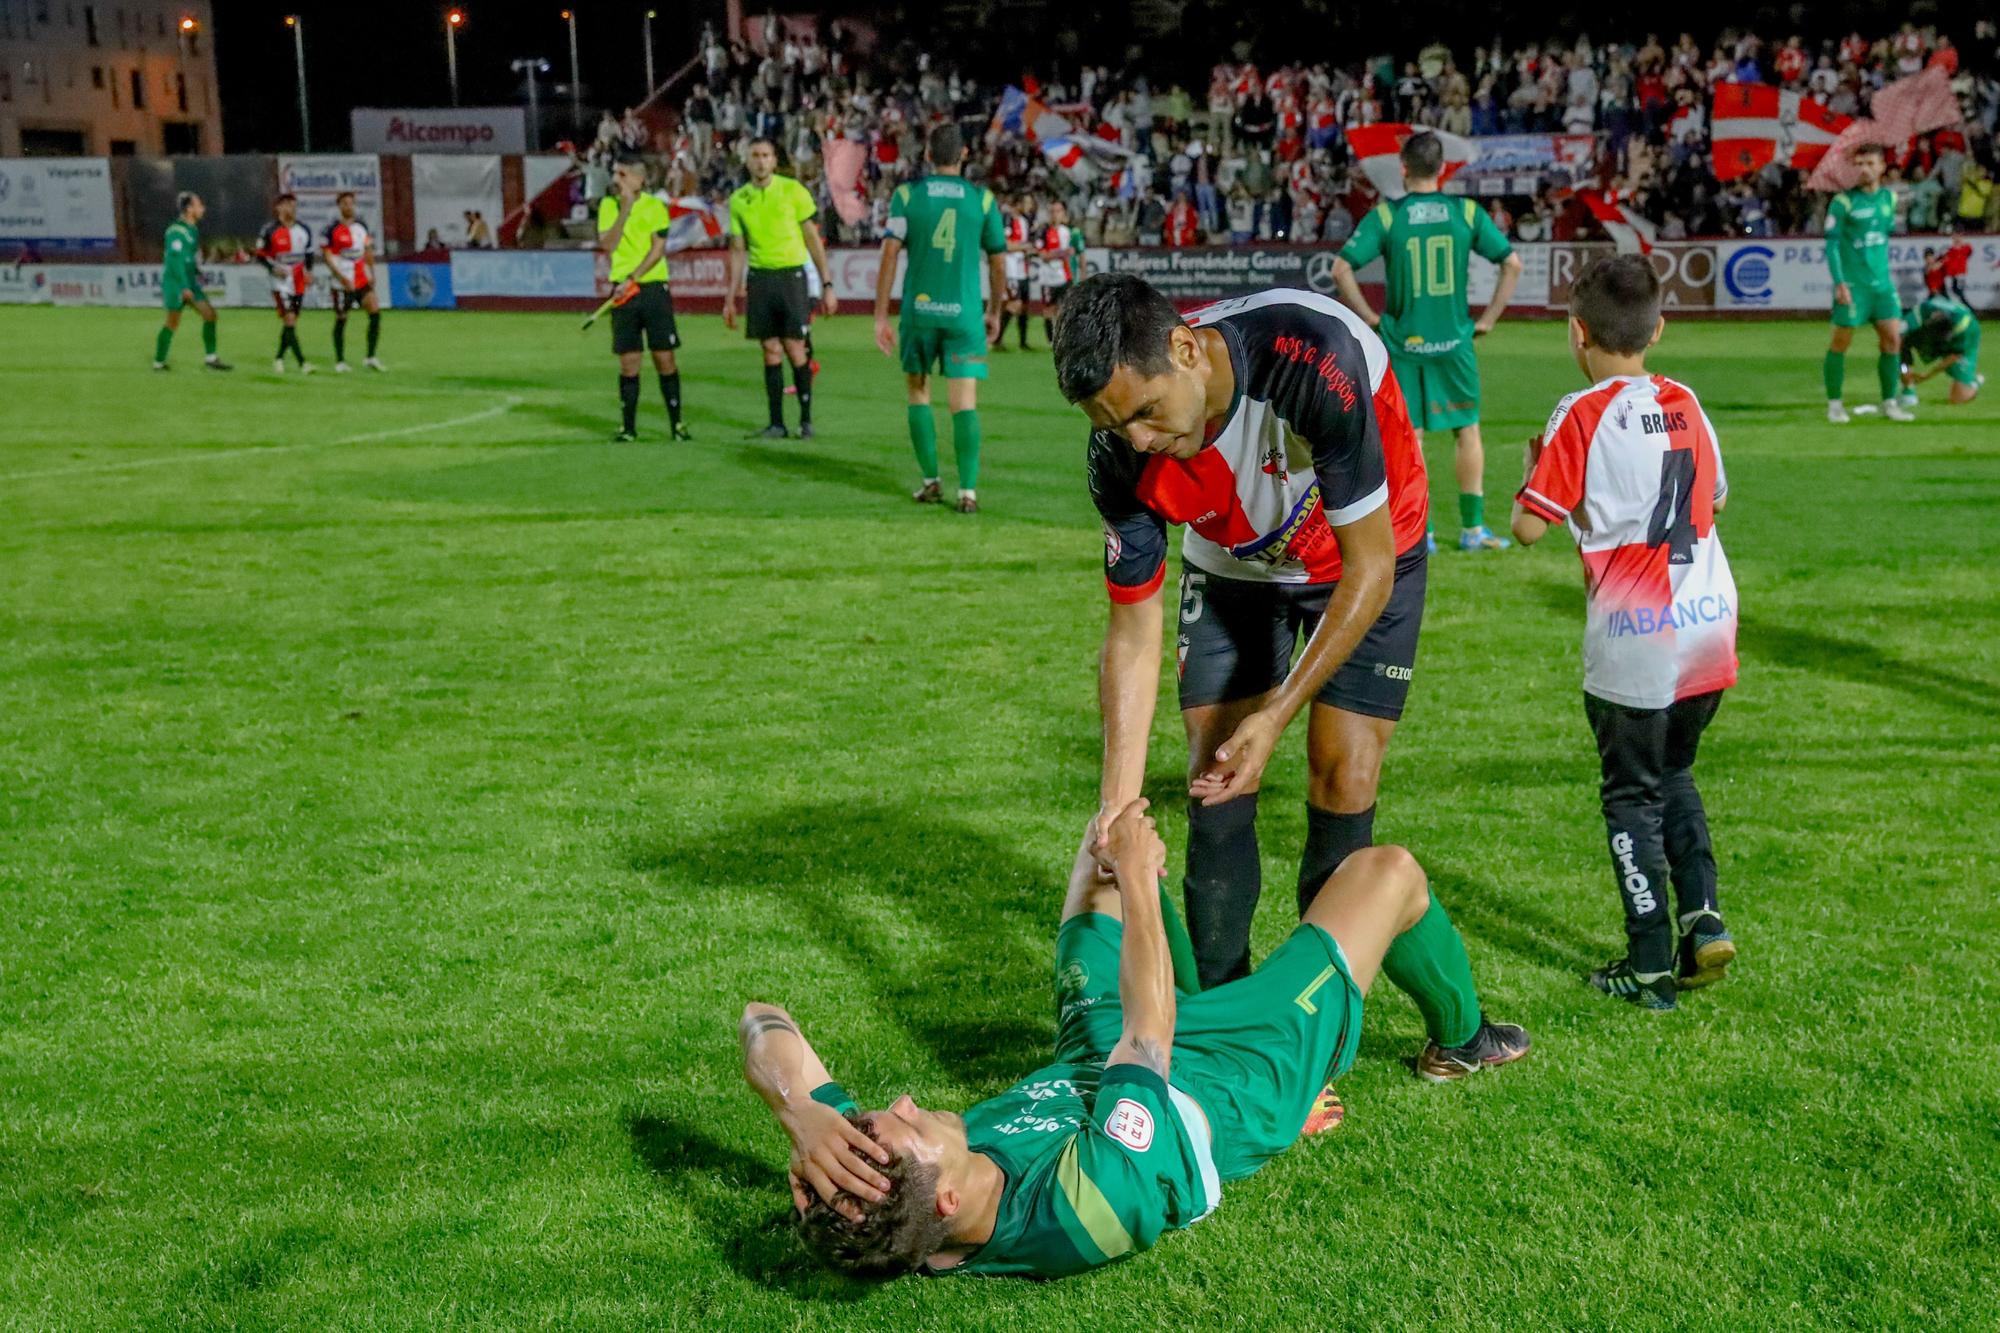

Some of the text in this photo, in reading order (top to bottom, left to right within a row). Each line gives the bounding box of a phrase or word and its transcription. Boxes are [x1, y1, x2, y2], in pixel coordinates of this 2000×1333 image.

[386, 116, 494, 149] Alcampo
[931, 207, 956, 263] 4
[1112, 250, 1300, 271] Talleres Fernández García
[1406, 235, 1455, 298] 10
[1640, 411, 1688, 435] BRAIS
[1646, 447, 1698, 565] 4
[1611, 831, 1657, 915] GIOS
